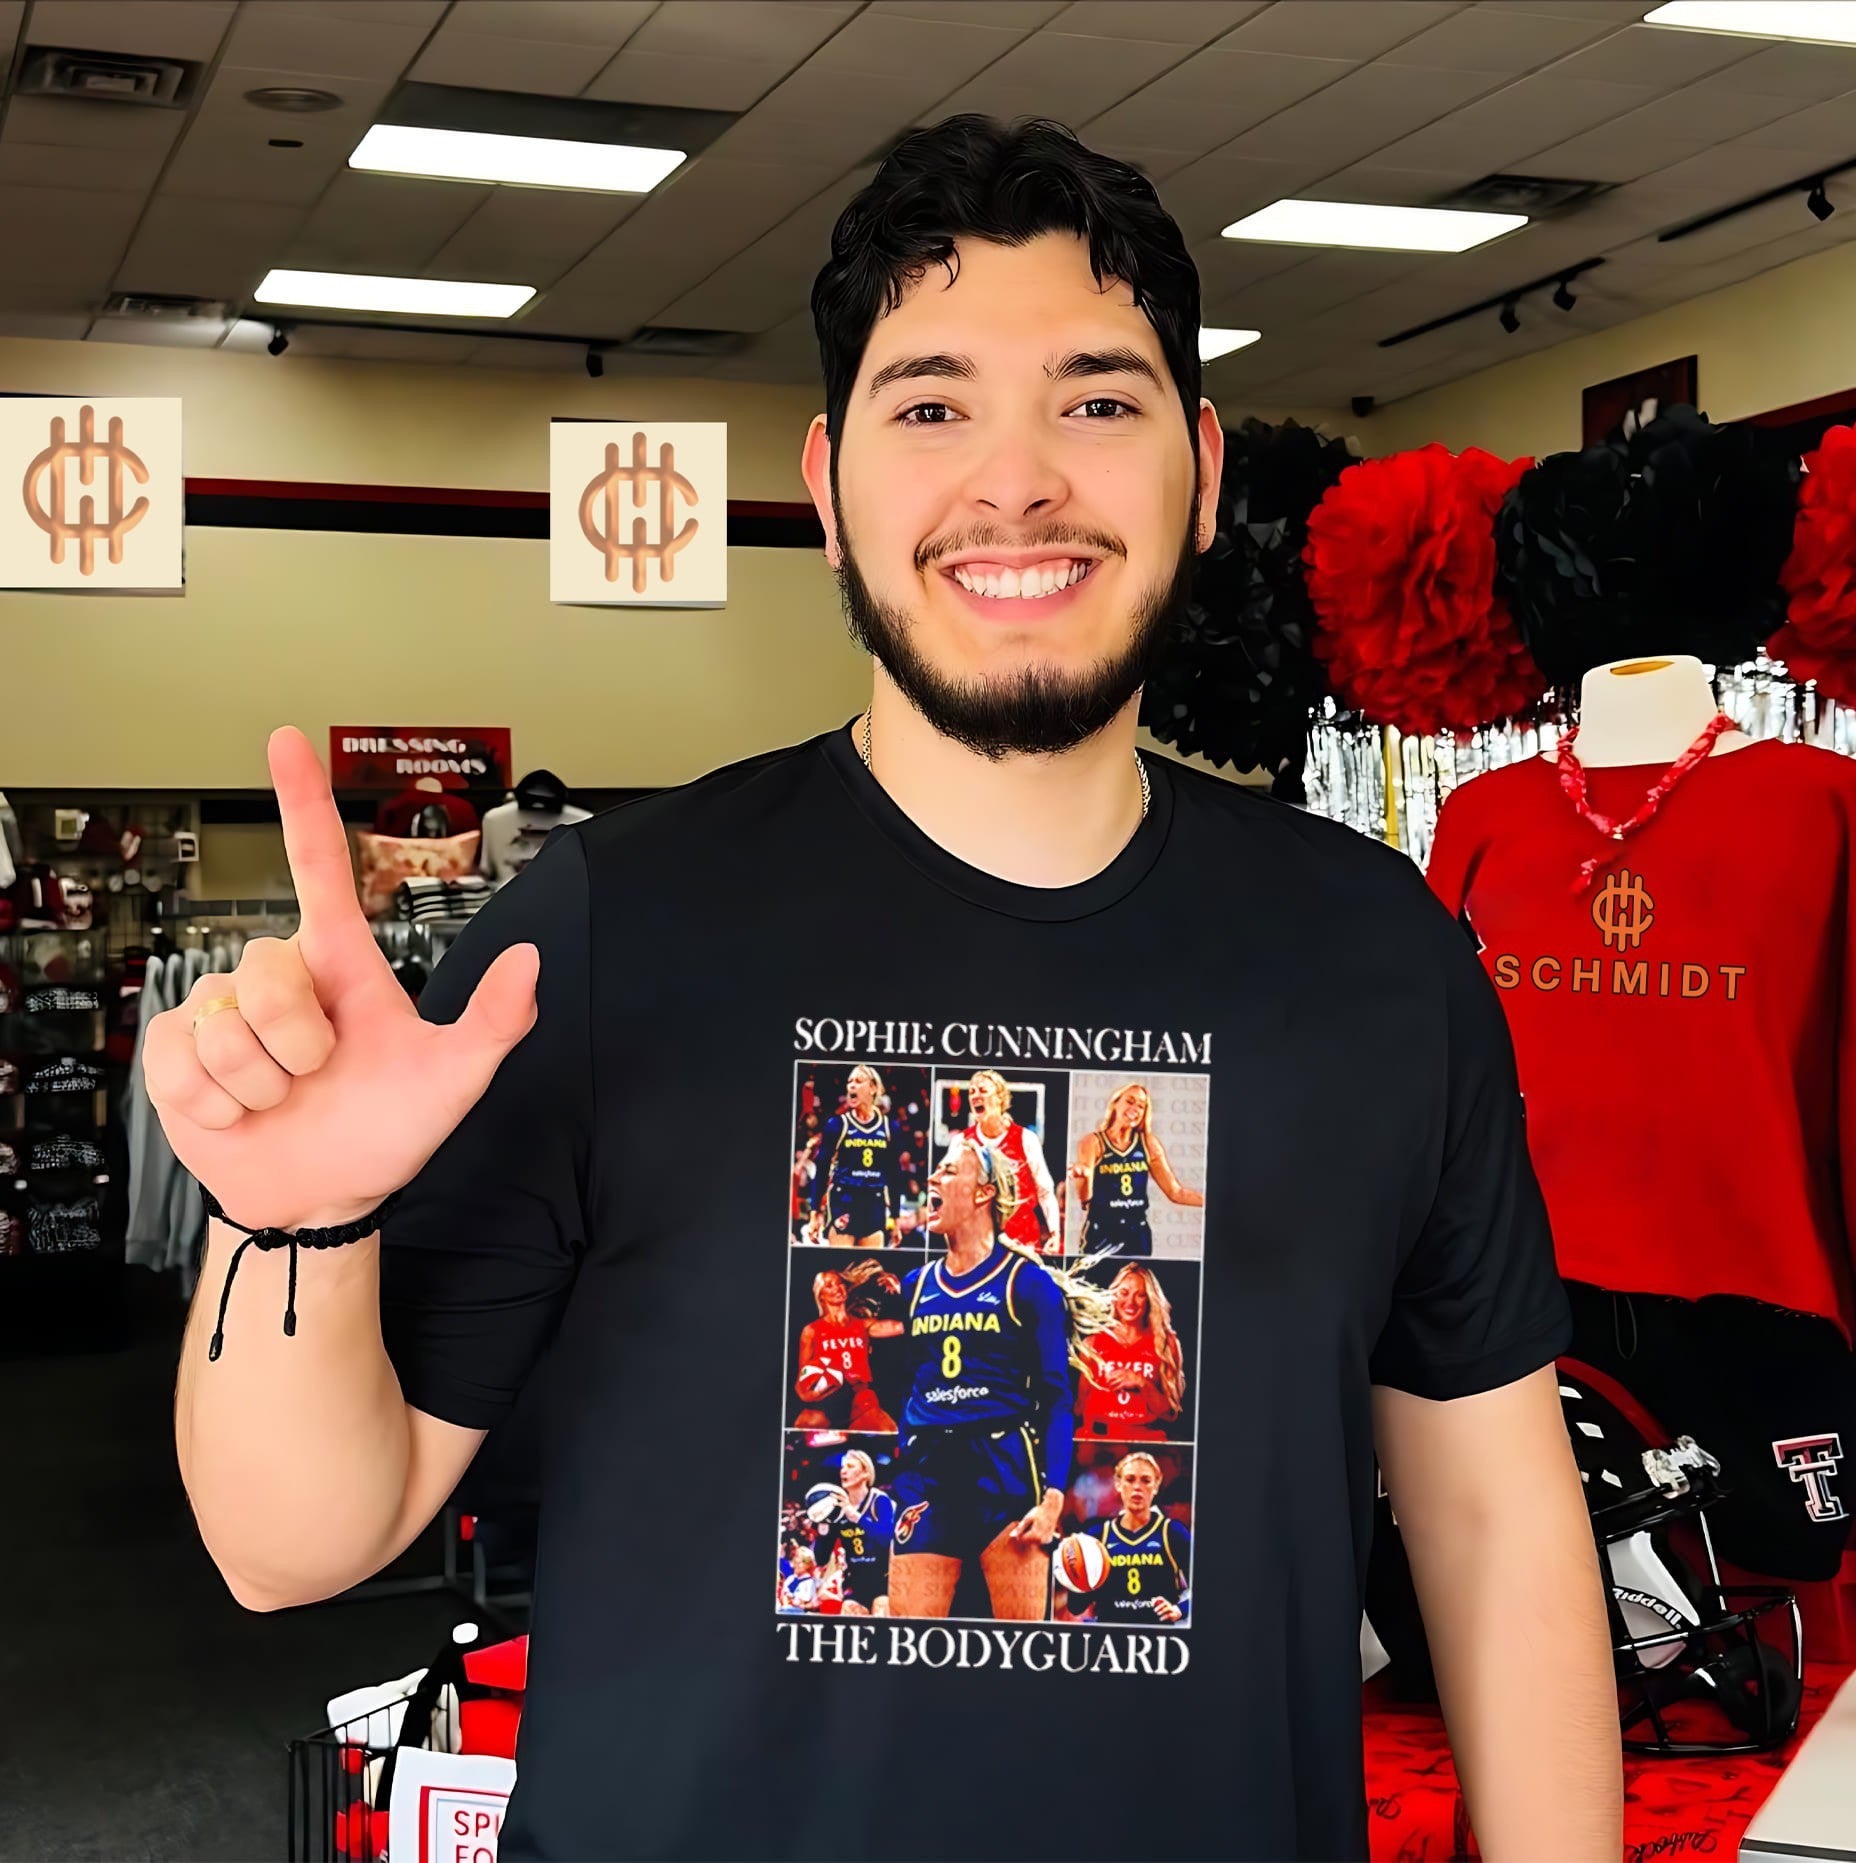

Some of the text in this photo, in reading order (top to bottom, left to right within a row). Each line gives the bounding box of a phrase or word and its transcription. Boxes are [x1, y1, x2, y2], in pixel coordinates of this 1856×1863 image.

[396, 758, 487, 775] ROOMS
[1493, 953, 1747, 1000] SCHMIDT
[793, 1017, 1212, 1064] SOPHIE CUNNINGHAM
[862, 1147, 873, 1168] 8
[1099, 1161, 1148, 1174] INDIANA
[1120, 1174, 1133, 1196] 8
[911, 1312, 1001, 1336] INDIANA
[822, 1337, 864, 1351] FEVER
[841, 1351, 852, 1369] 8
[941, 1335, 962, 1379] 8
[925, 1385, 989, 1404] salesforce
[852, 1537, 864, 1555] 8
[1109, 1553, 1163, 1567] NDIANA
[1127, 1567, 1141, 1595] 8
[776, 1622, 1190, 1675] THE BODYGUARD
